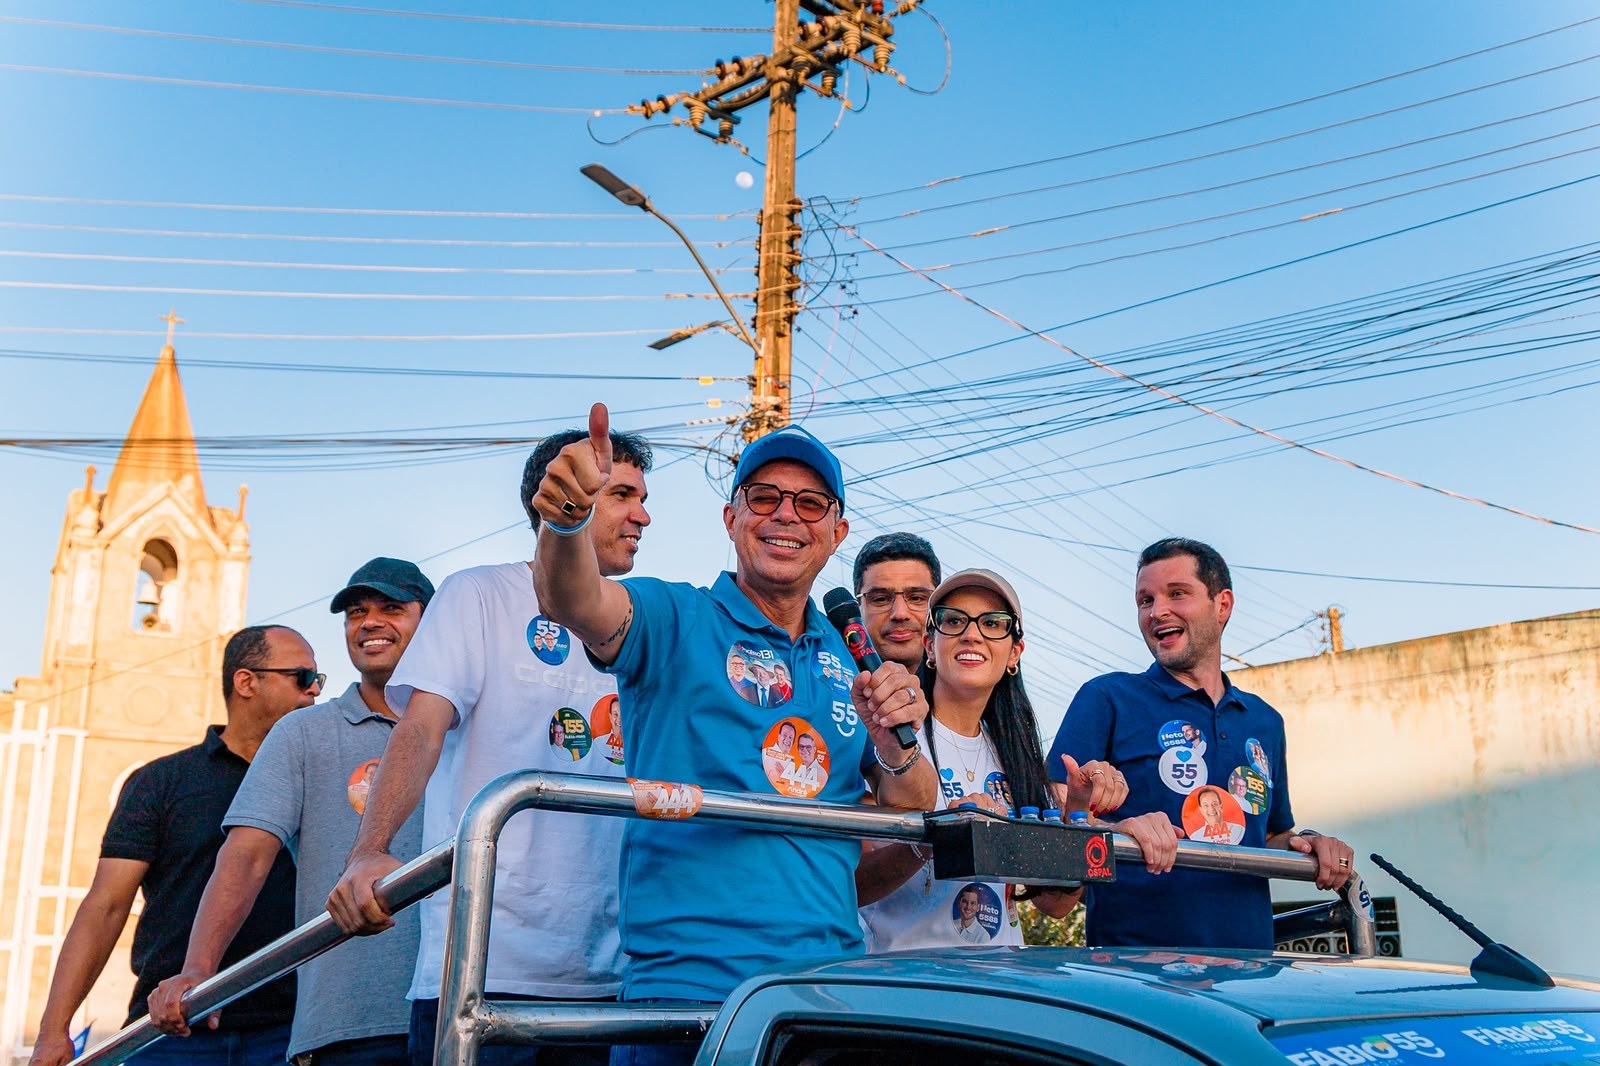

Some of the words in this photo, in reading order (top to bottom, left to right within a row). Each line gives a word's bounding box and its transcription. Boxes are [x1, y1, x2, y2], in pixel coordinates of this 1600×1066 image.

[536, 620, 561, 638] 55
[817, 651, 842, 668] 55
[831, 700, 858, 726] 55
[563, 719, 585, 734] 155
[1161, 732, 1183, 740] Neto
[780, 761, 820, 791] 444
[1171, 763, 1198, 779] 55
[942, 782, 964, 798] 55
[1246, 776, 1264, 793] 155
[652, 788, 696, 814] 444
[1203, 822, 1232, 840] 444
[1087, 867, 1112, 878] OSPAL
[980, 904, 999, 915] Neto
[979, 913, 999, 924] 5588
